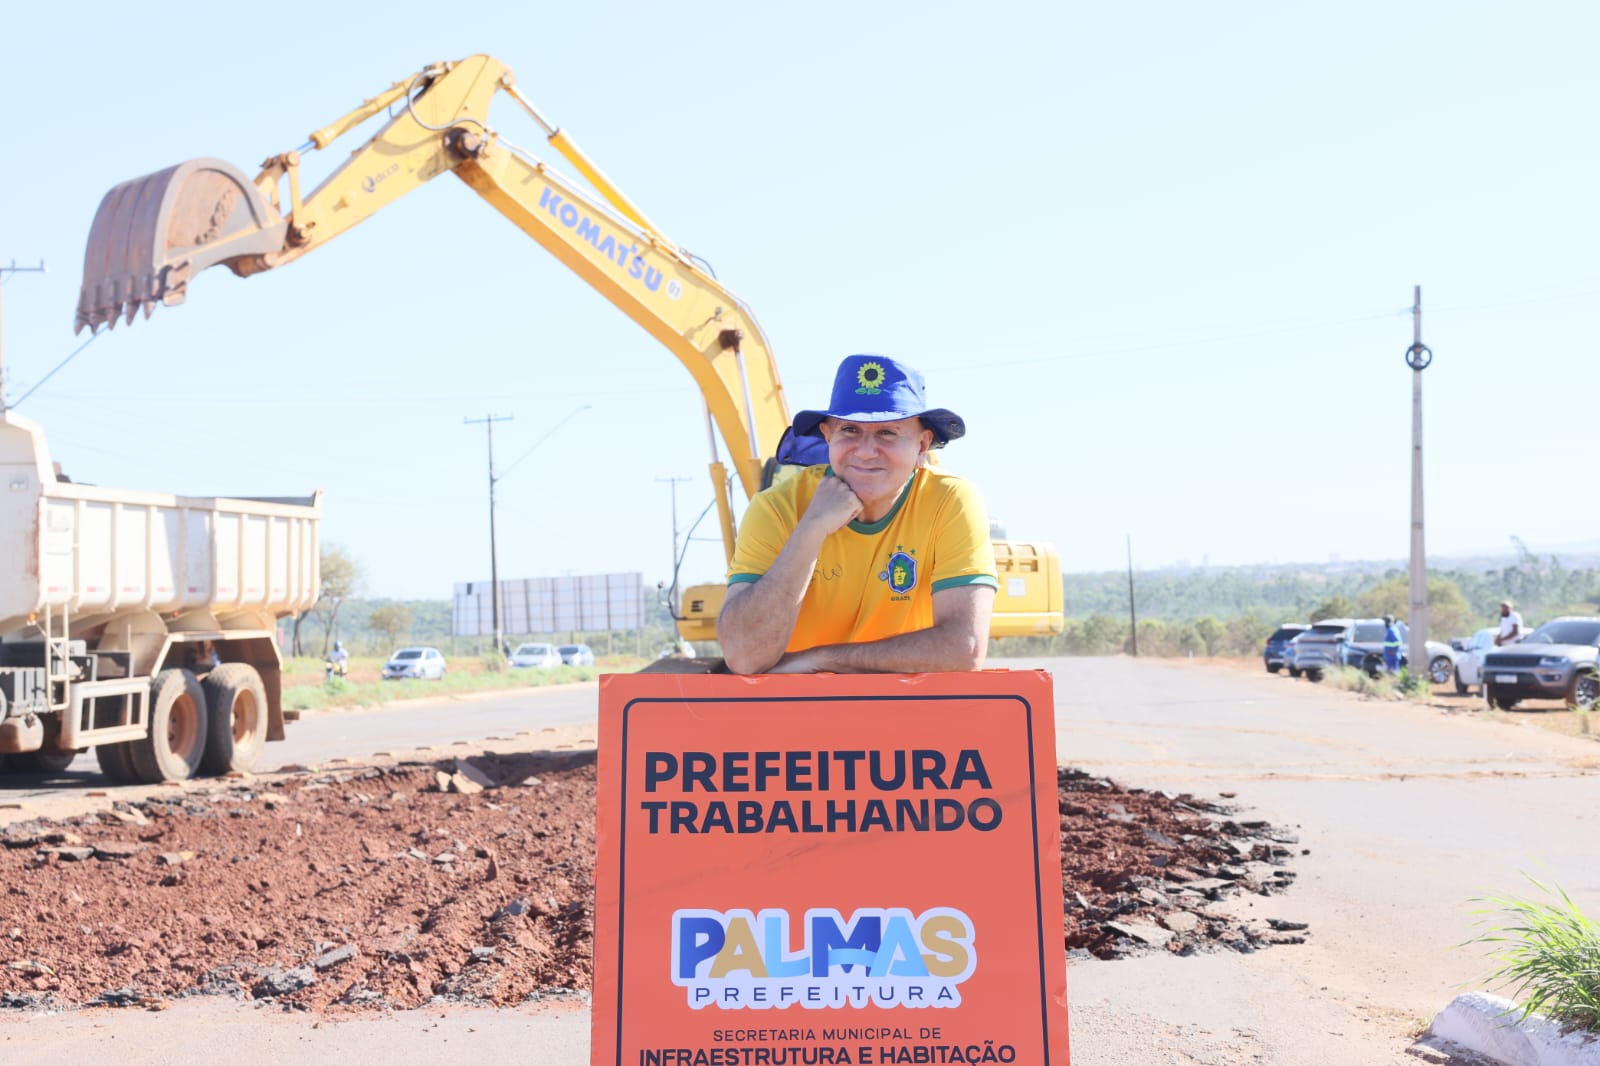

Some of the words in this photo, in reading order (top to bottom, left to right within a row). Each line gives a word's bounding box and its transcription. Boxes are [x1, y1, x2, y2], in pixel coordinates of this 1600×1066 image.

[539, 187, 663, 292] KOMATSU
[644, 749, 993, 793] PREFEITURA
[641, 797, 1003, 834] TRABALHANDO
[680, 915, 969, 979] PALMAS
[695, 986, 953, 1002] PREFEITURA
[639, 1047, 853, 1066] INFRAESTRUTURA
[858, 1046, 873, 1064] E
[880, 1039, 1016, 1066] HABITAÇÃO
[713, 1029, 816, 1042] SECRETARIA
[822, 1028, 912, 1041] MUNICIPAL
[919, 1028, 942, 1040] DE
